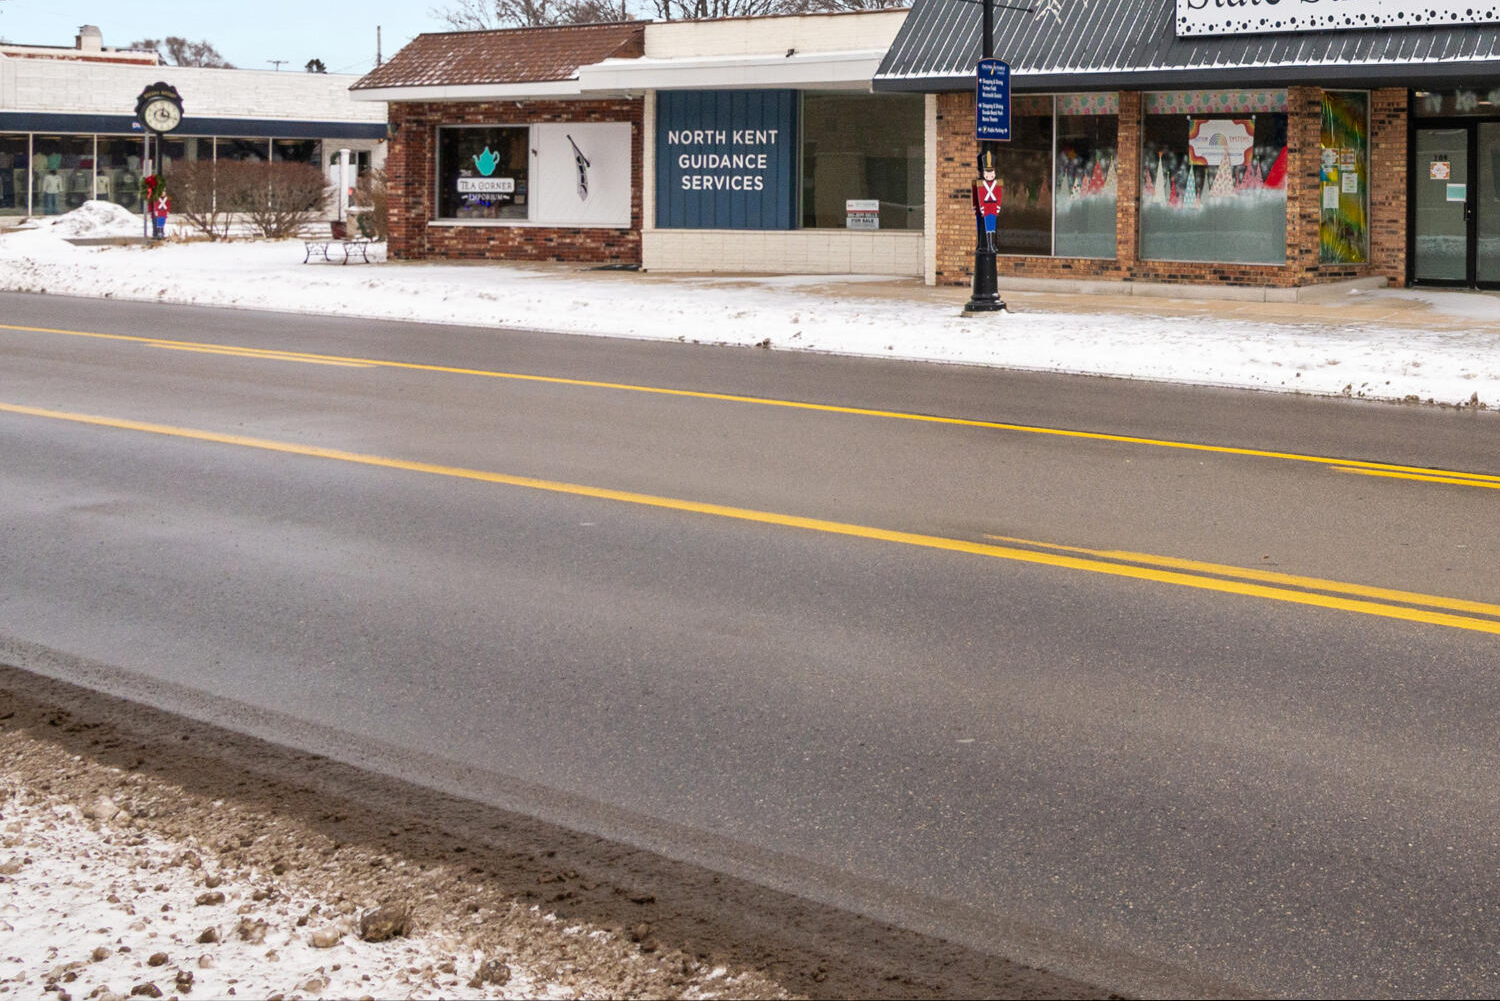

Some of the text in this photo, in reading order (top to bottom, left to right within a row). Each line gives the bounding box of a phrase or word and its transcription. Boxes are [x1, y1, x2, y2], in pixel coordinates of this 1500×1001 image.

[668, 129, 778, 145] NORTH KENT
[678, 154, 767, 169] GUIDANCE
[460, 181, 512, 191] TEA CORNER
[681, 175, 764, 190] SERVICES
